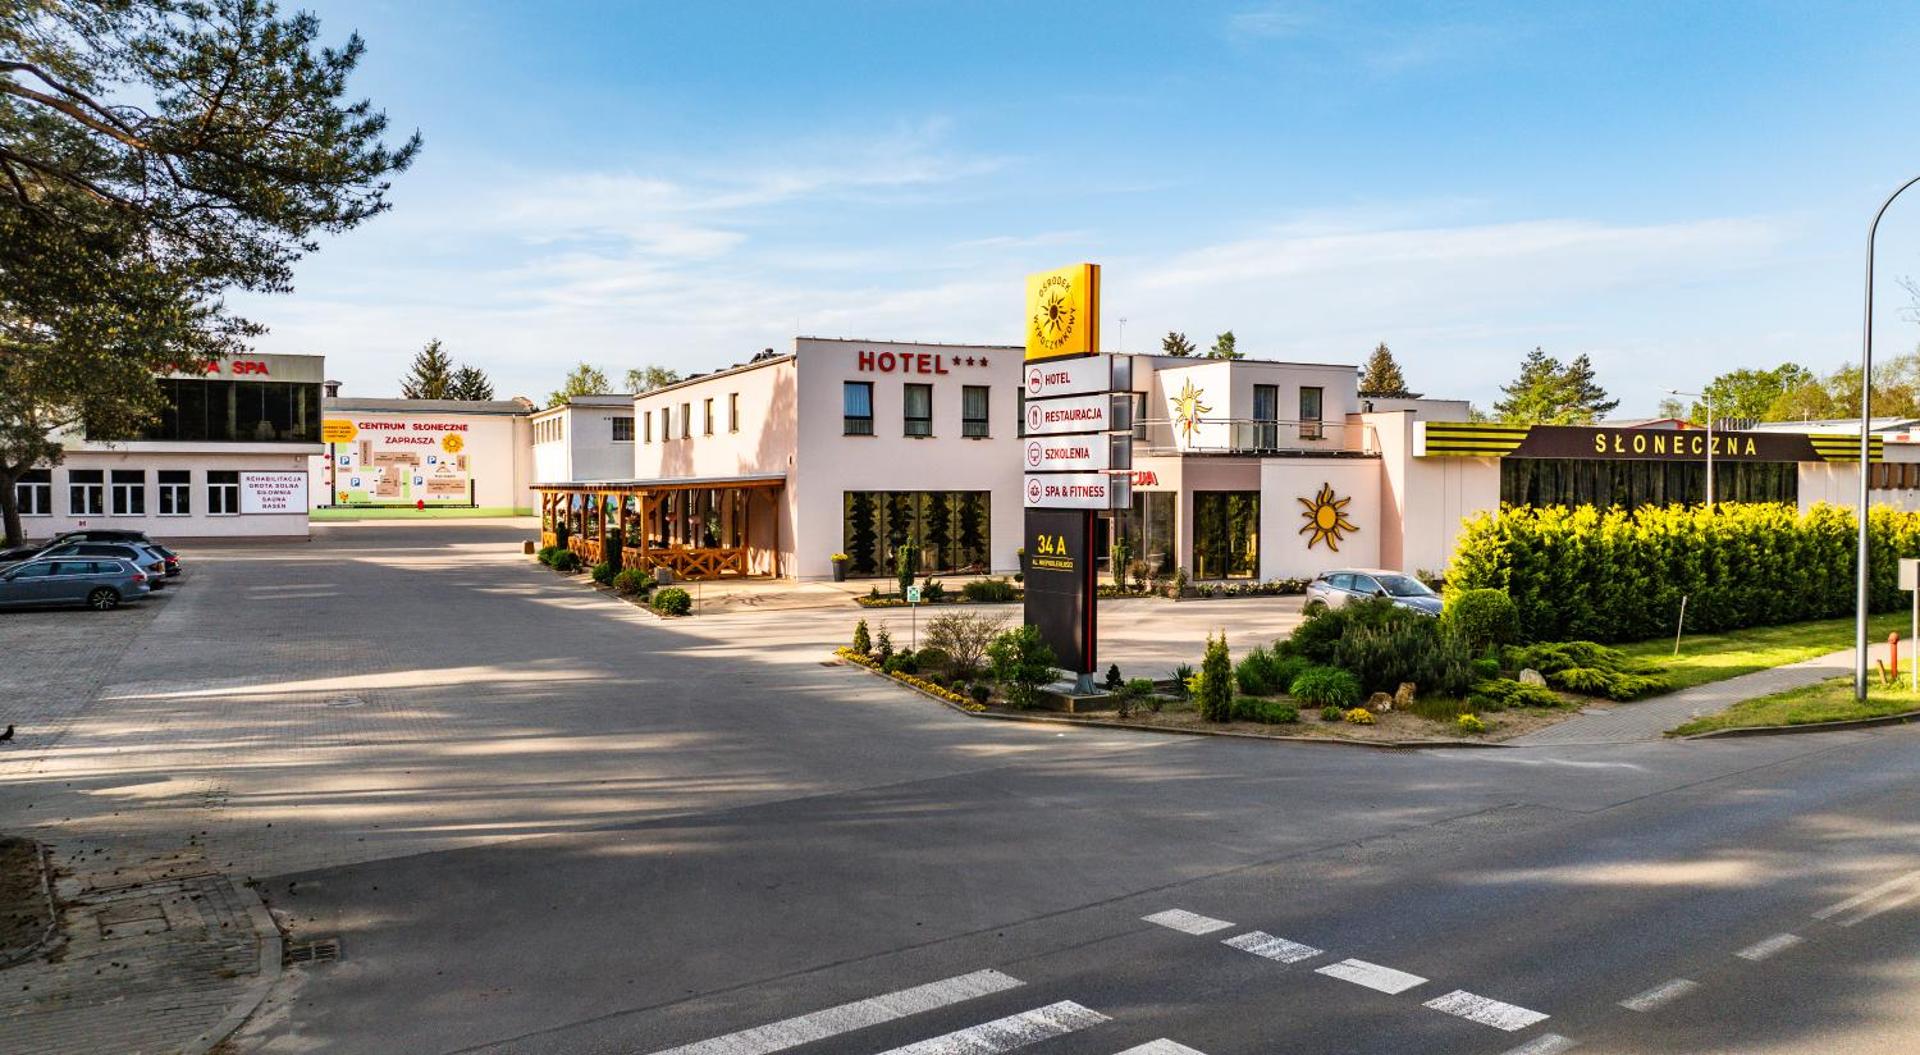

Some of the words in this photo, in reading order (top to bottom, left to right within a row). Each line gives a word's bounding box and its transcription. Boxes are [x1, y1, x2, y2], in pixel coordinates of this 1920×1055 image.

[1039, 276, 1071, 297] OŚRODEK
[1033, 307, 1076, 350] WYPOCZYNKOWY
[231, 360, 270, 375] SPA
[858, 351, 949, 375] HOTEL
[1044, 372, 1071, 386] HOTEL
[1044, 408, 1103, 422] RESTAURACJA
[358, 421, 406, 431] CENTRUM
[412, 422, 470, 432] SŁONECZNE
[385, 435, 436, 446] ZAPRASZA
[1595, 433, 1757, 456] SŁONECZNA
[1044, 447, 1090, 460] SZKOLENIA
[1044, 485, 1060, 498] SPA
[1061, 486, 1068, 497] &
[1069, 485, 1105, 498] FITNESS
[1037, 534, 1055, 555] 34
[1056, 535, 1067, 556] A
